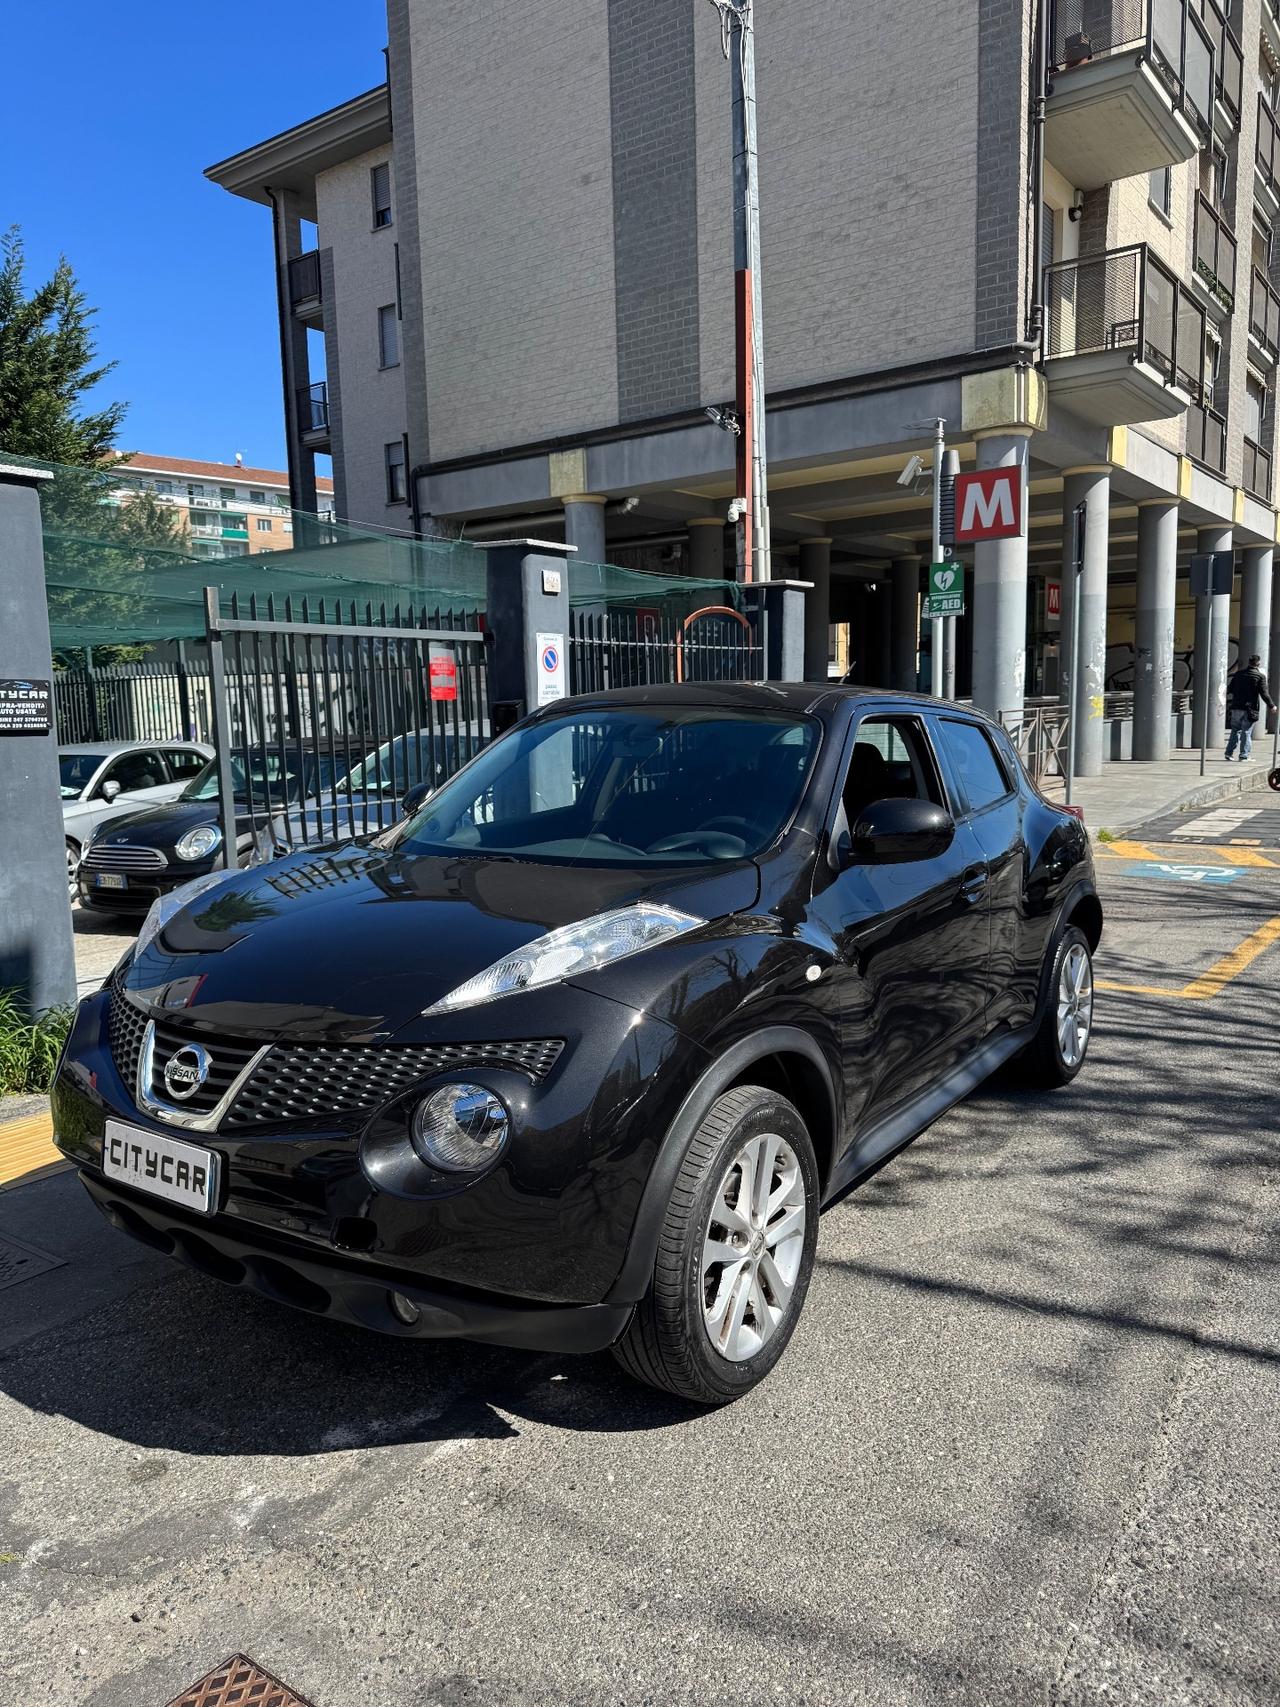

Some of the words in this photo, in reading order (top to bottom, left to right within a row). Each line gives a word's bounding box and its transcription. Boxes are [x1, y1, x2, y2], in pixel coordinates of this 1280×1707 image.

[960, 478, 1015, 531] M
[941, 598, 961, 610] AED
[1049, 588, 1059, 609] M
[167, 1065, 199, 1080] NISSAN
[110, 1137, 206, 1196] CITYCAR
